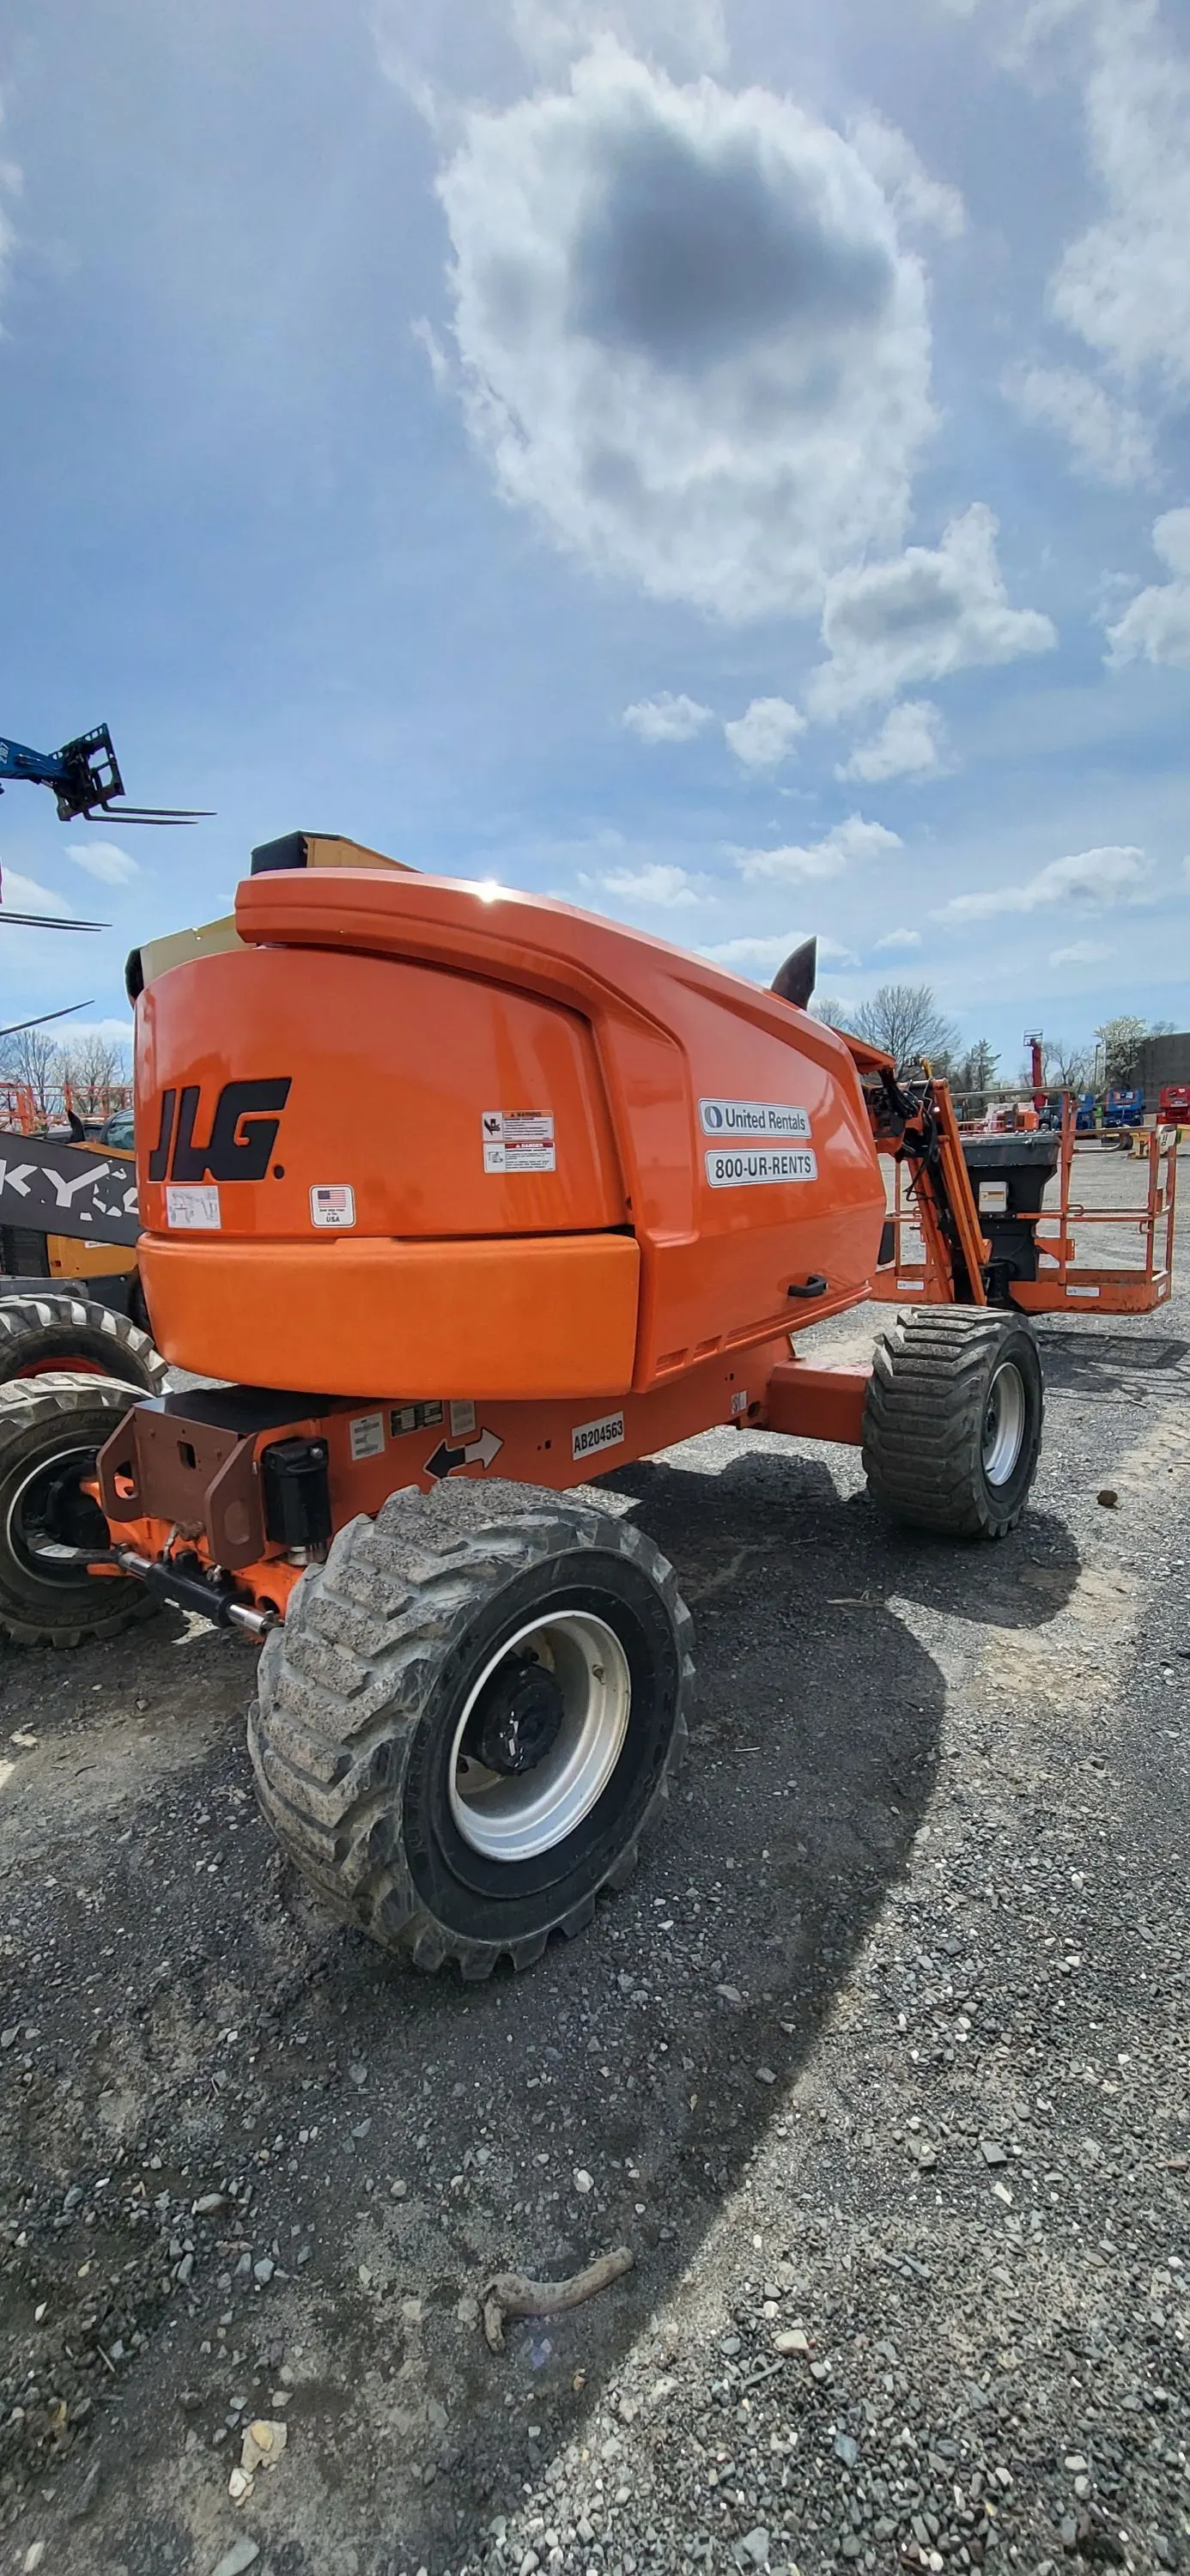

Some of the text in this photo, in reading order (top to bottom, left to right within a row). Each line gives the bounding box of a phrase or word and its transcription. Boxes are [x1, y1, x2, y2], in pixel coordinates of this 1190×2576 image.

[726, 1109, 805, 1130] United Rentals
[716, 1157, 811, 1178] 800-UR-RENTS
[574, 1420, 622, 1453] AB204563
